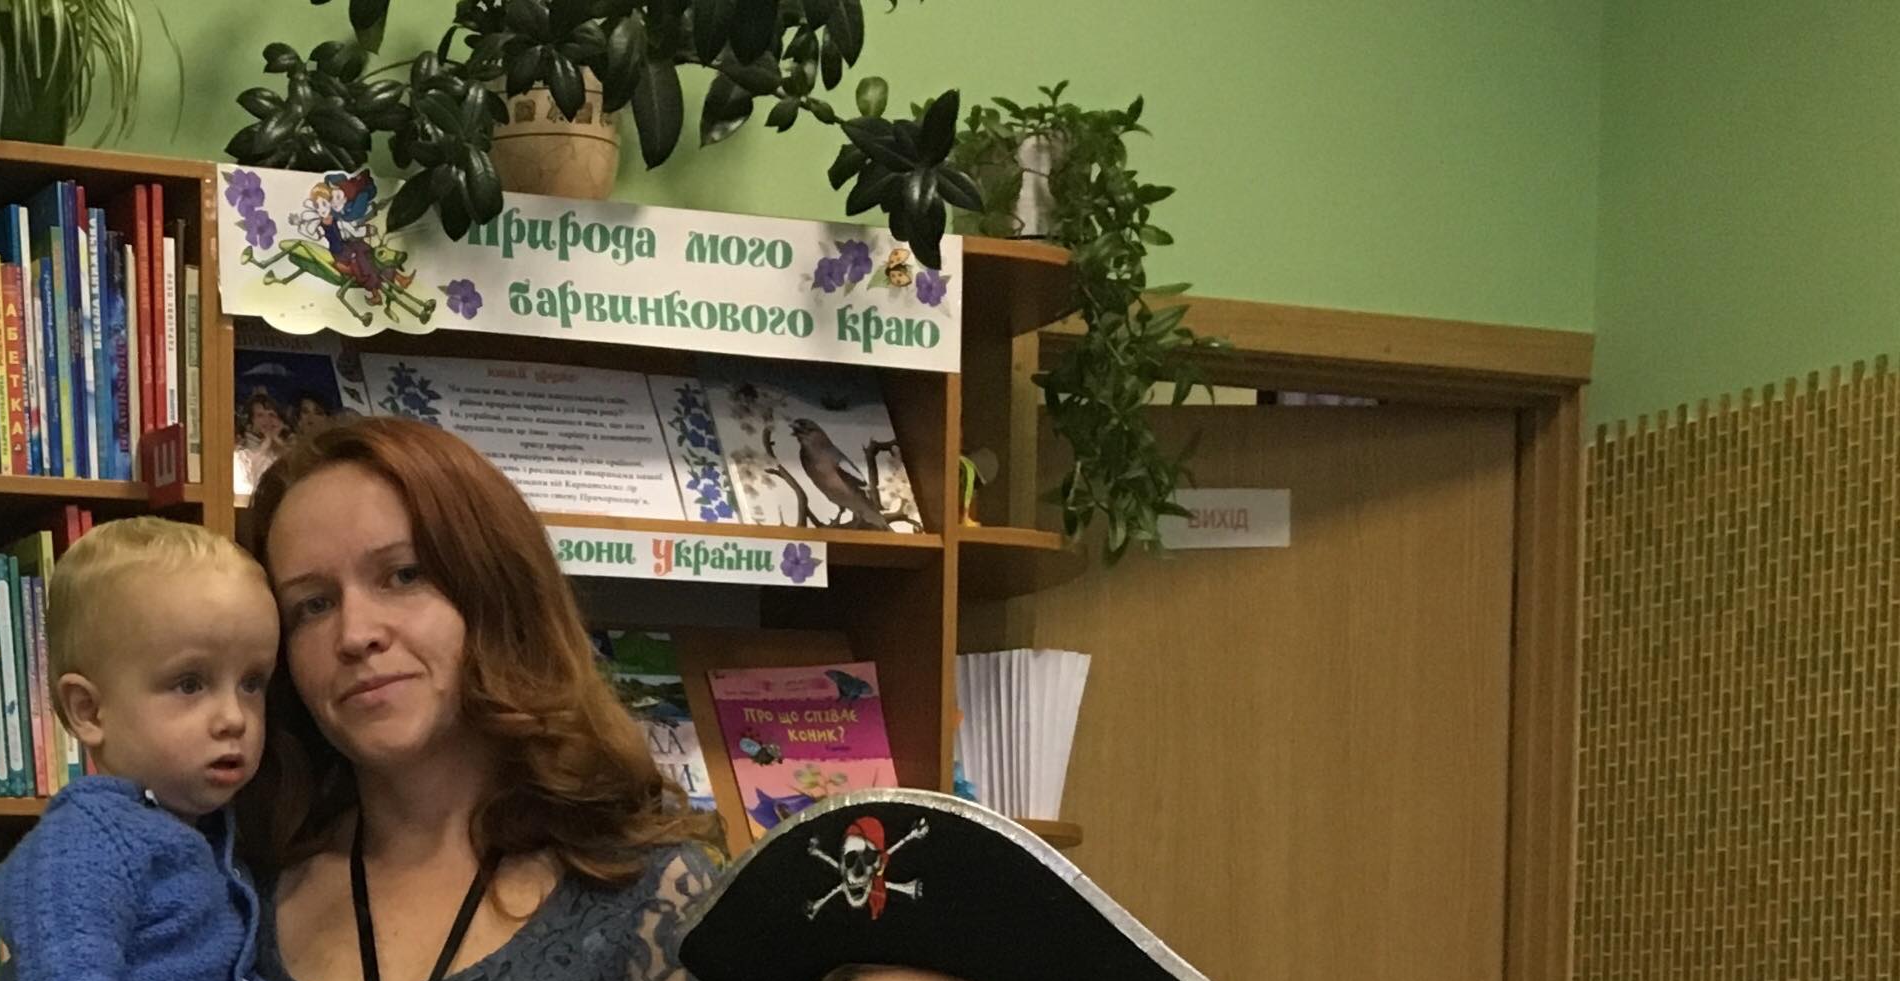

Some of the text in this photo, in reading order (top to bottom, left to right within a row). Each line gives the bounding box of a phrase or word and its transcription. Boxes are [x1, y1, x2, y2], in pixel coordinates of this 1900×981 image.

[684, 230, 793, 269] мого
[90, 298, 102, 350] ВЕСЕЛА
[508, 279, 940, 354] барвинкового краю
[6, 302, 24, 436] АБЕТКА
[154, 443, 173, 488] Ш
[1187, 506, 1250, 533] ВИХІД
[557, 538, 775, 577] зони України
[743, 707, 774, 723] ПРО
[787, 726, 846, 744] КОНИК?
